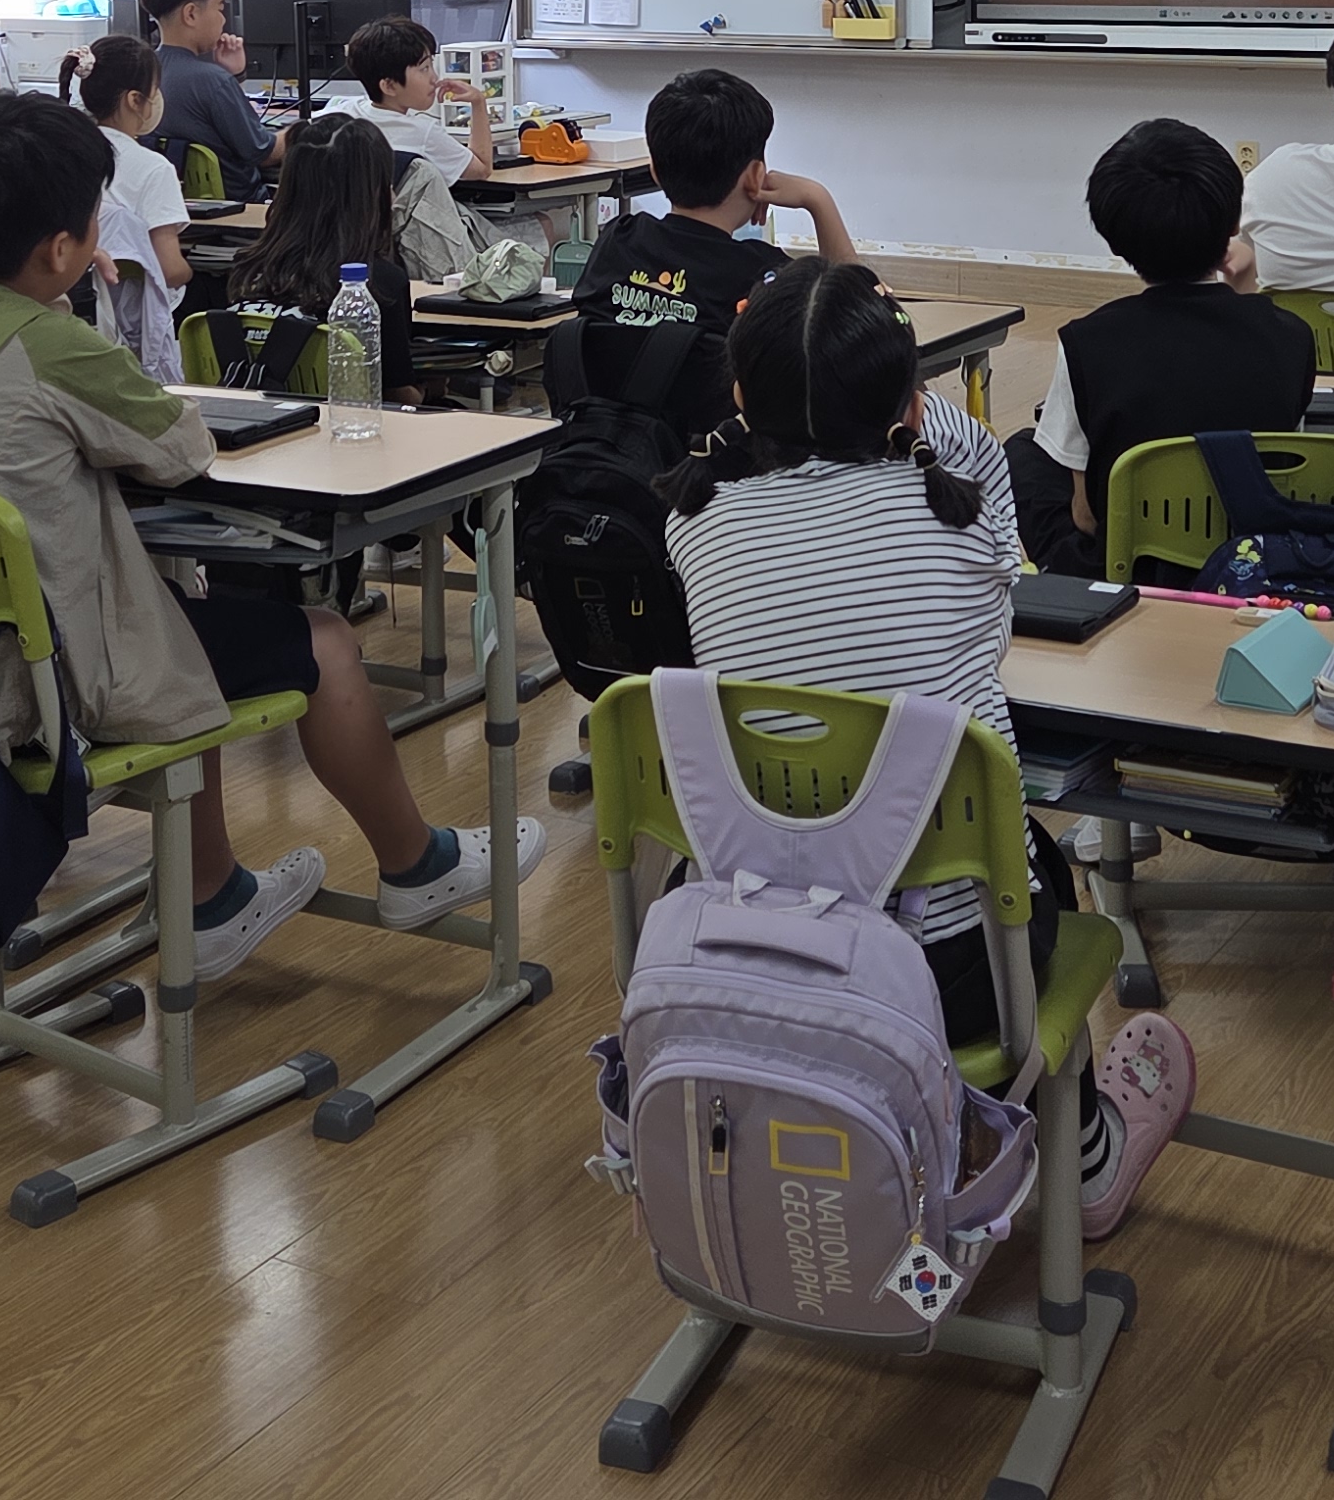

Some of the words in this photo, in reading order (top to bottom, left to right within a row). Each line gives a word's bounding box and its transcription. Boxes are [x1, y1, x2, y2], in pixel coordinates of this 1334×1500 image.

[611, 282, 698, 323] SUMMER
[779, 1180, 825, 1316] GEOGRAPHIC
[814, 1187, 854, 1295] NATIONAL
